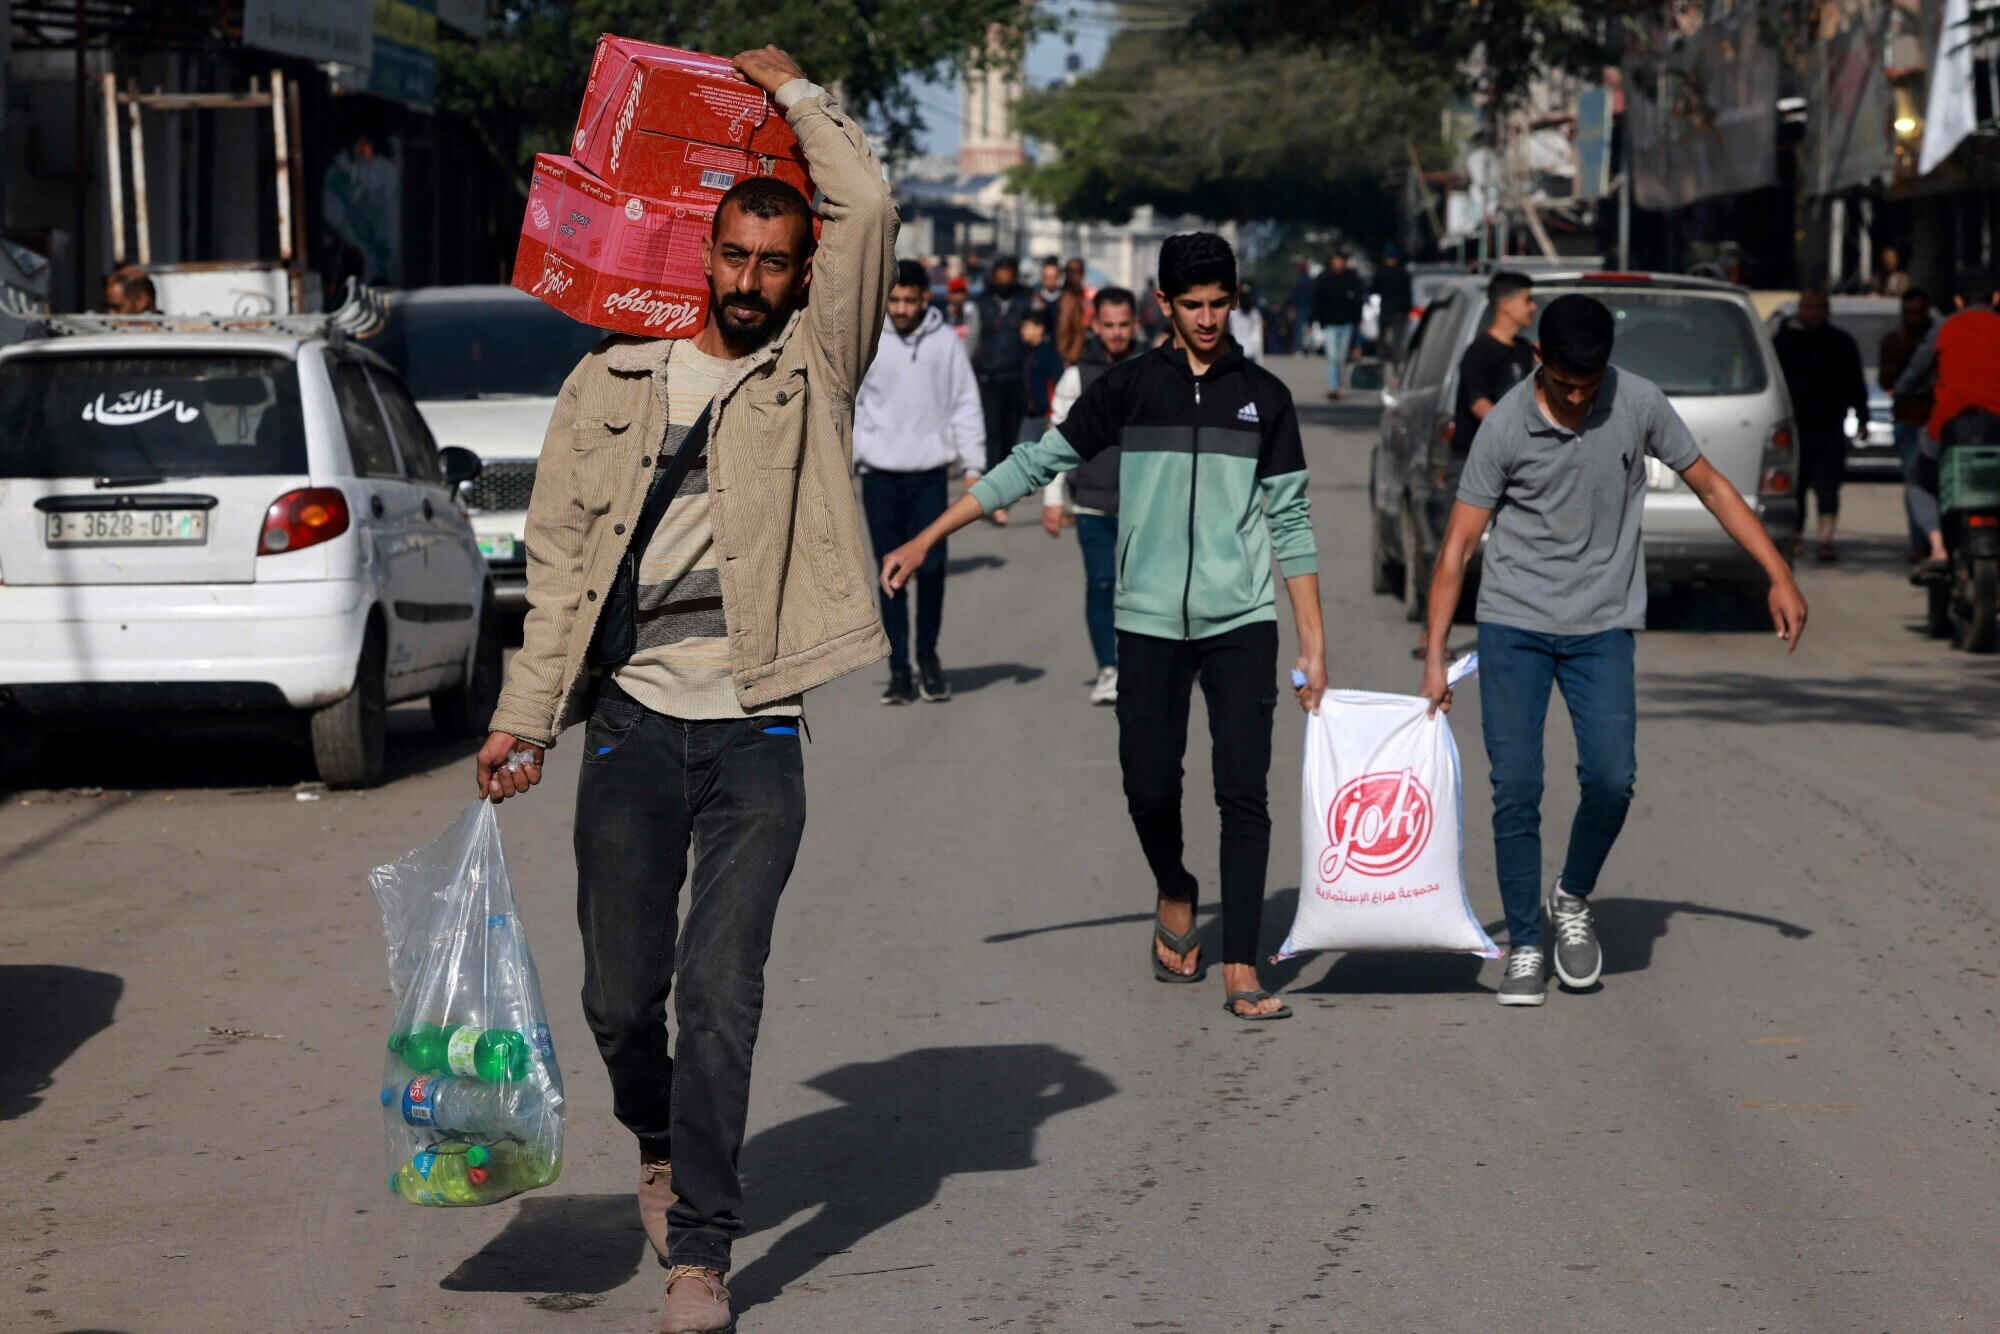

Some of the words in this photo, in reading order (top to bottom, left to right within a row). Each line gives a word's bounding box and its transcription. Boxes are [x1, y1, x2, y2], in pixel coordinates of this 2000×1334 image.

[610, 70, 644, 174] Kellogg's
[655, 290, 679, 299] Noodles
[680, 293, 702, 302] Instant
[603, 287, 700, 332] Kellogg's
[1372, 891, 1397, 904] هزاع
[1399, 883, 1440, 899] مجموعة
